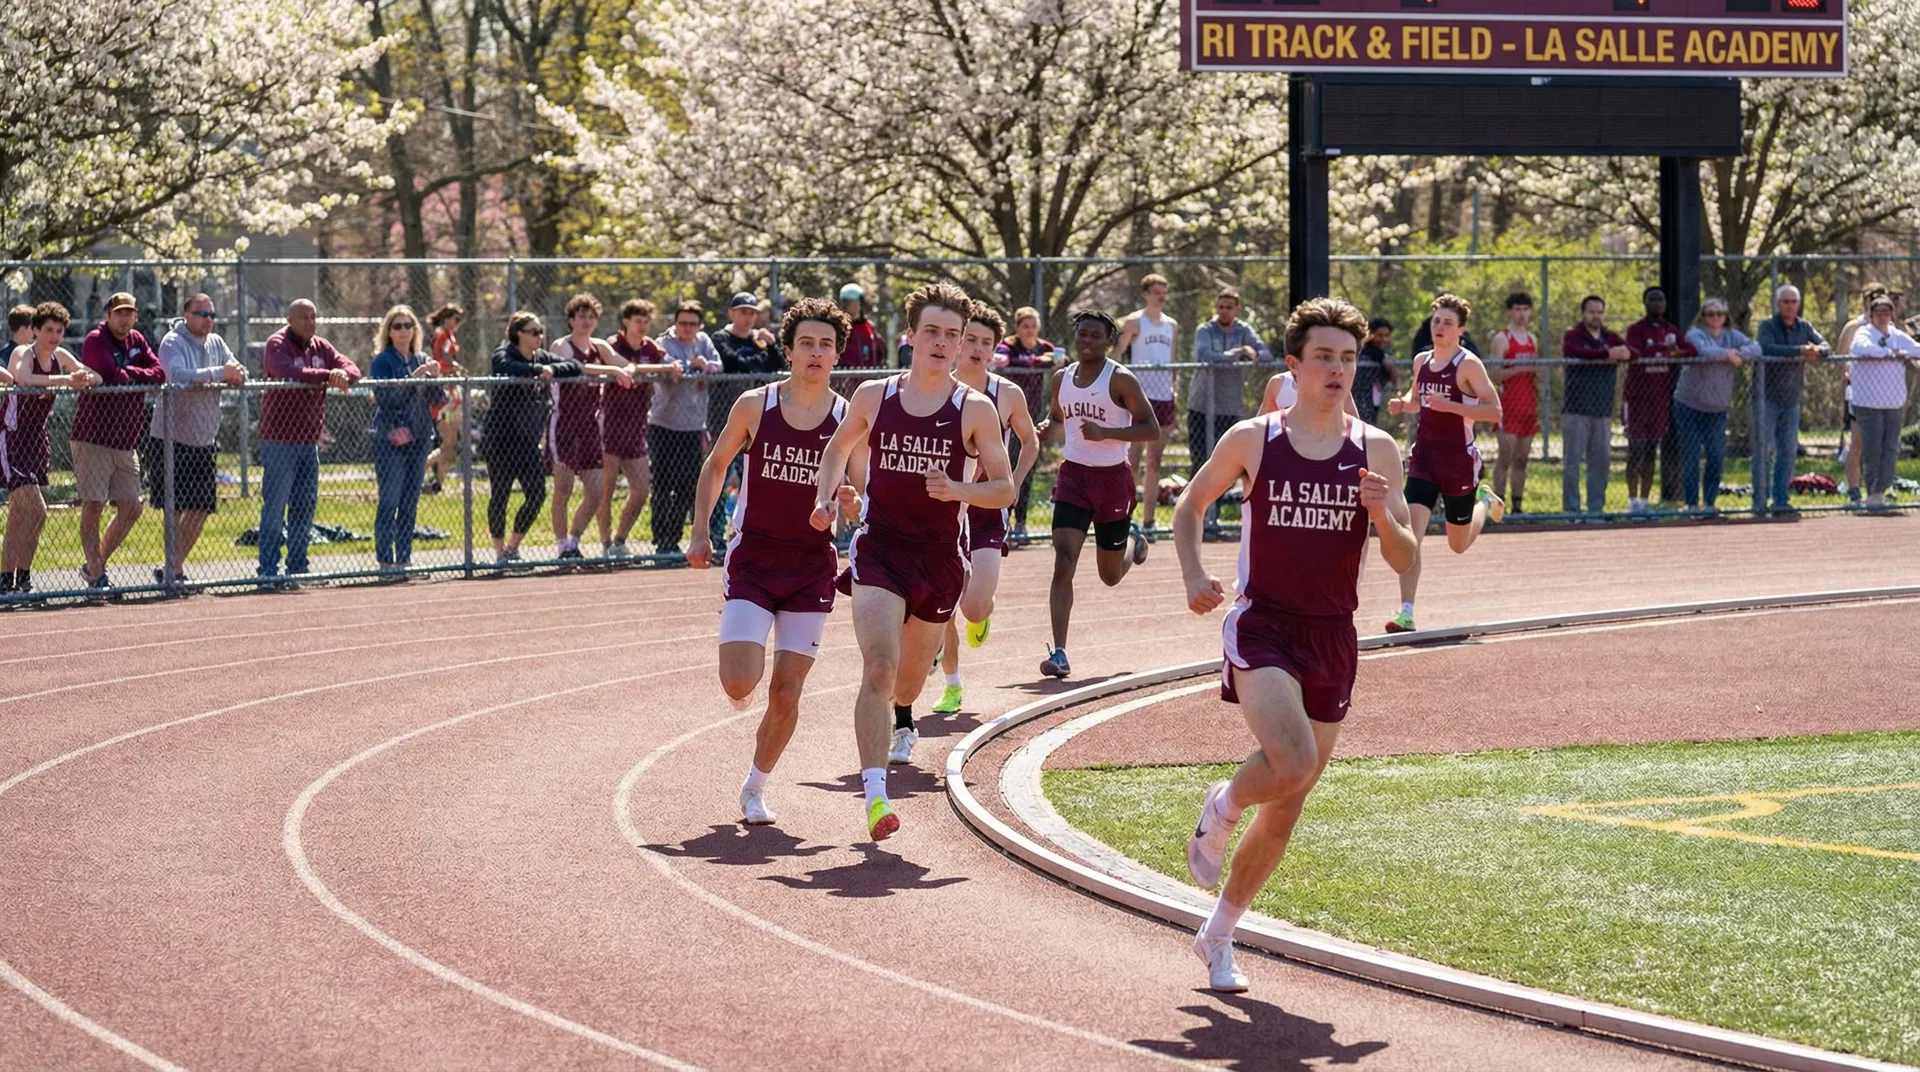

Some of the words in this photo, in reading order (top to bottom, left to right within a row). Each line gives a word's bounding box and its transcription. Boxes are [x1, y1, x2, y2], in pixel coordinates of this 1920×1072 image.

[1202, 23, 1235, 58] RI
[1245, 24, 1359, 60] TRACK
[1366, 25, 1392, 60] &
[1402, 26, 1493, 60] FIELD
[1525, 27, 1567, 61] LA
[1575, 27, 1675, 63] SALLE
[1683, 29, 1839, 65] ACADEMY
[1063, 403, 1074, 420] LA
[1074, 401, 1106, 422] SALLE
[763, 442, 782, 462] LA
[785, 446, 821, 467] SALL
[880, 432, 899, 451] LA
[902, 435, 953, 457] SALLE
[761, 461, 820, 487] ACADEM
[1268, 479, 1293, 502] LA
[1298, 482, 1359, 507] SALLE
[1267, 504, 1356, 531] ACADEMY
